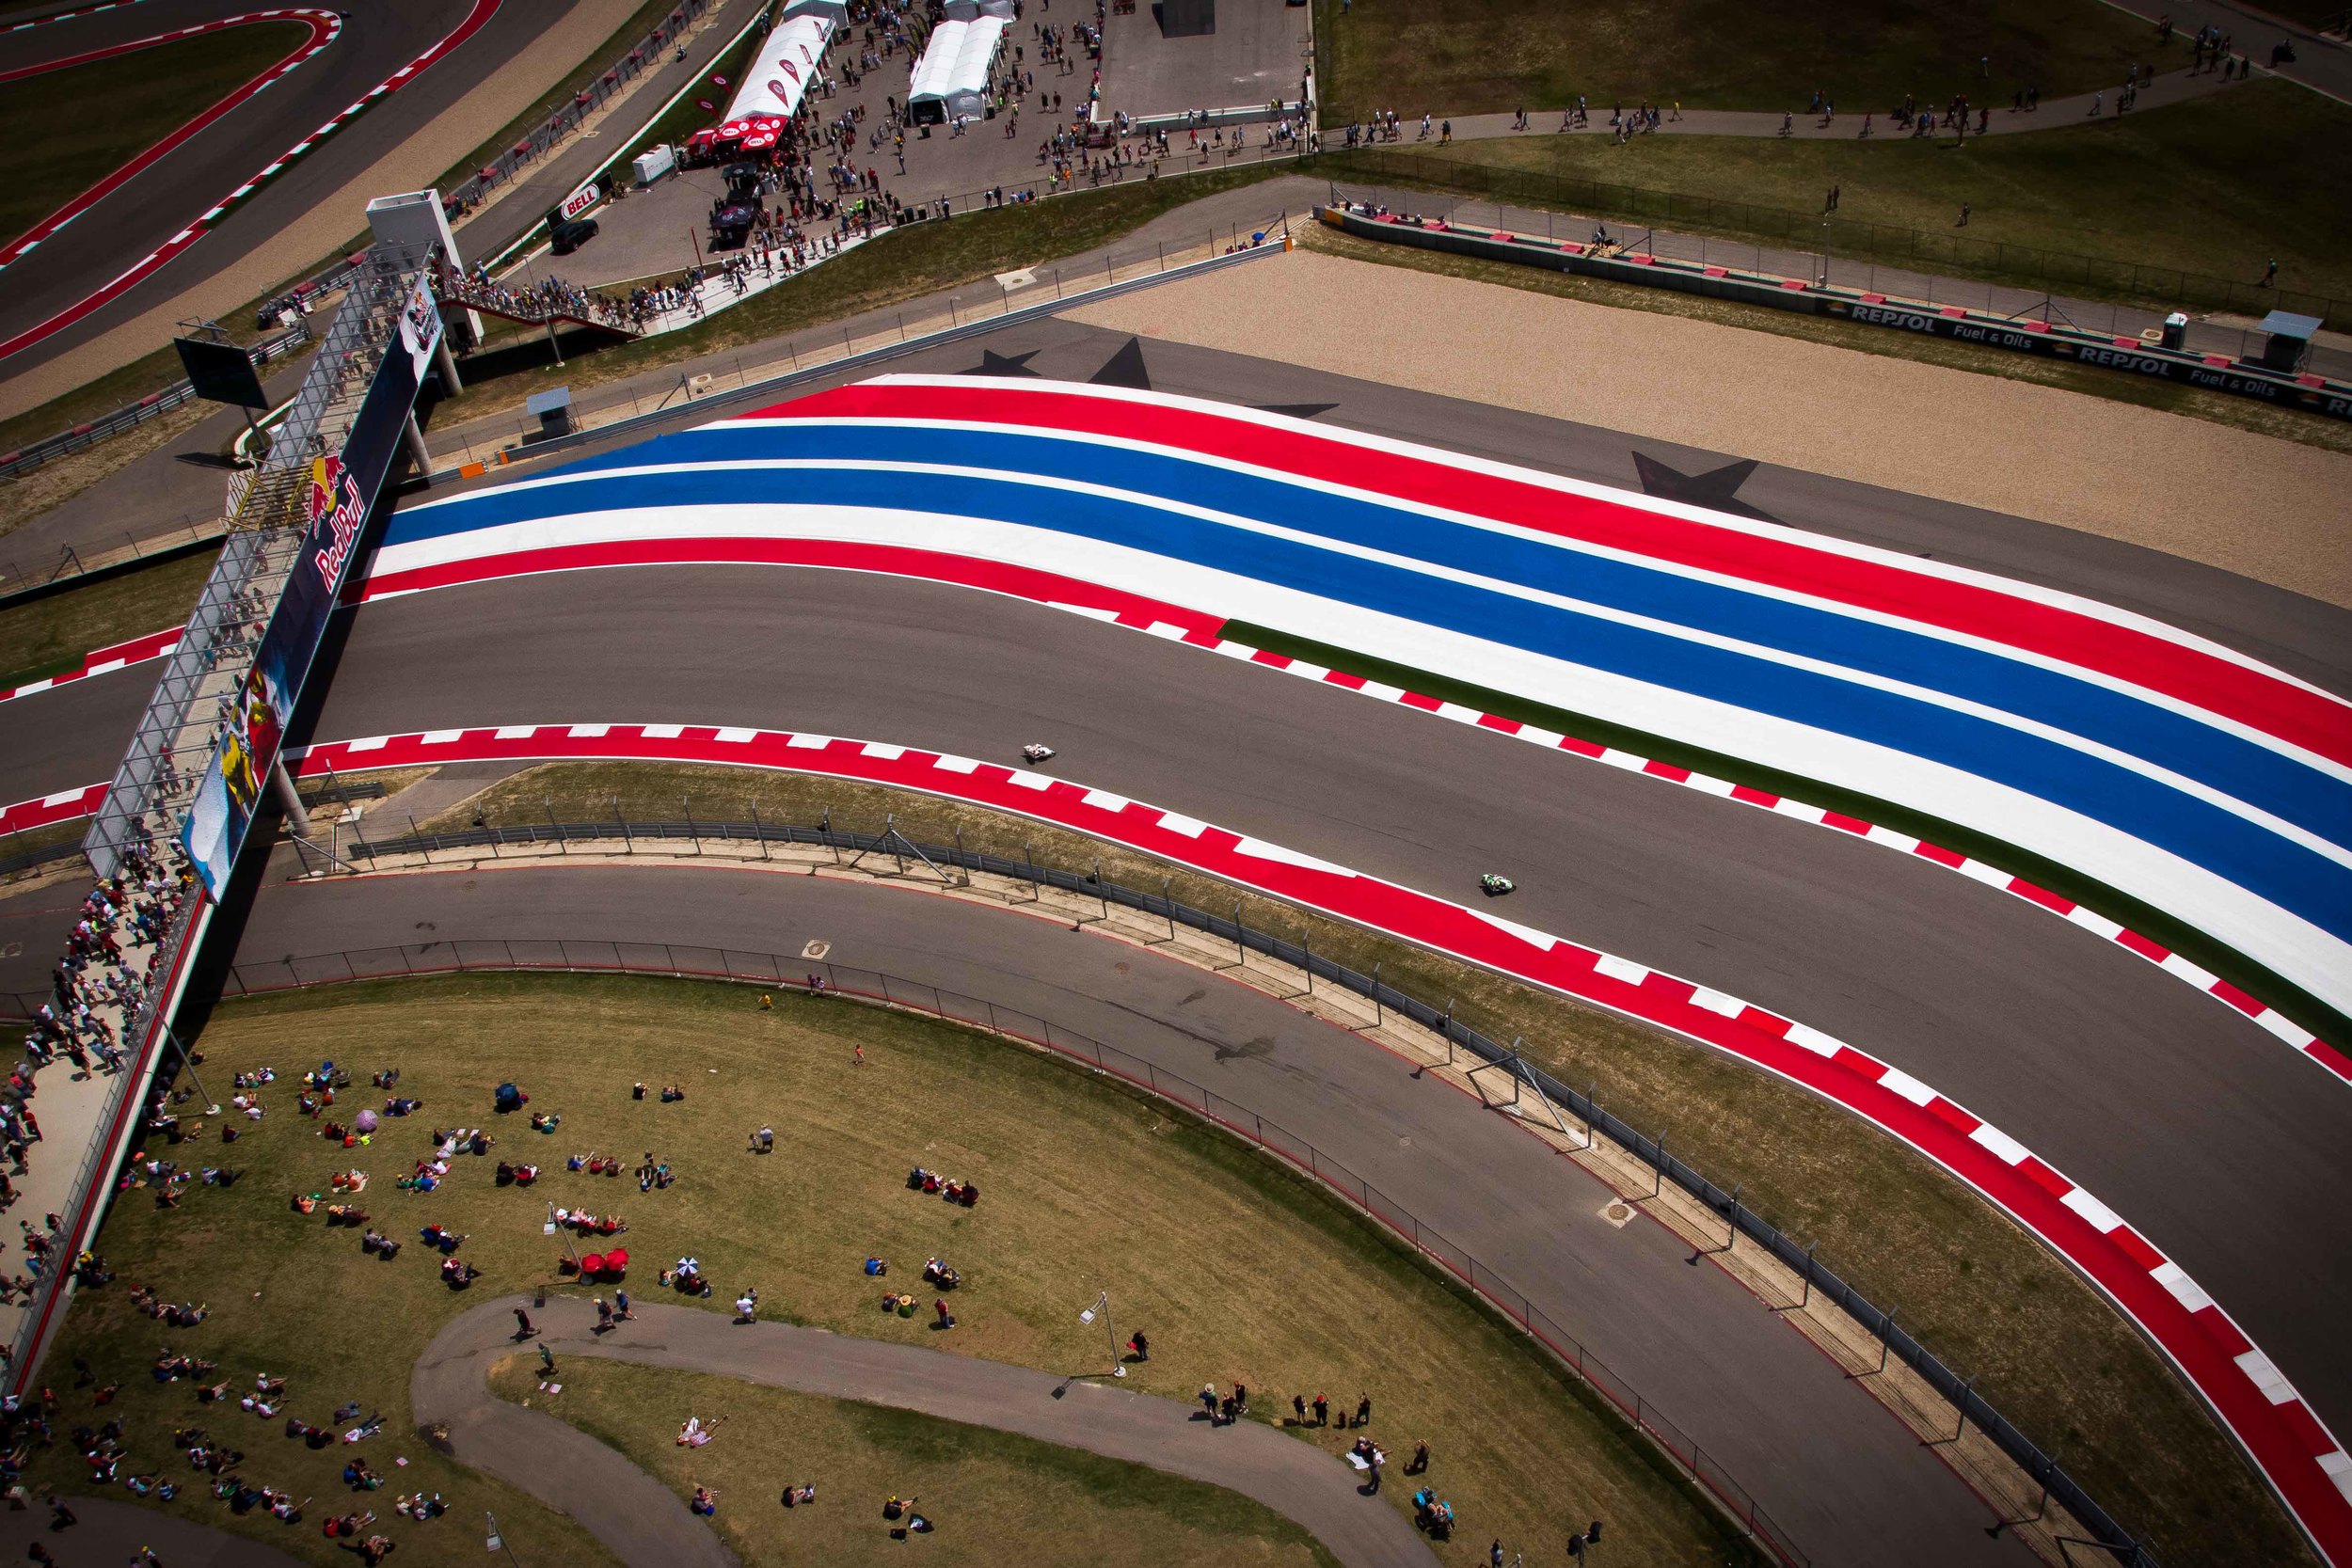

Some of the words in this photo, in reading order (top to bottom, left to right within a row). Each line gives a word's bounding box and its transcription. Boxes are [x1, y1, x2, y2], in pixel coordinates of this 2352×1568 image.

[566, 191, 596, 215] BELL
[1851, 306, 1935, 332] REPSOL
[1954, 325, 1986, 341] Fuel
[1990, 333, 1999, 343] &
[2003, 333, 2033, 349] Oils
[2078, 346, 2170, 376] REPSOL
[2190, 369, 2224, 387] Fuel
[2230, 378, 2240, 388] &
[2244, 380, 2277, 397] Oils
